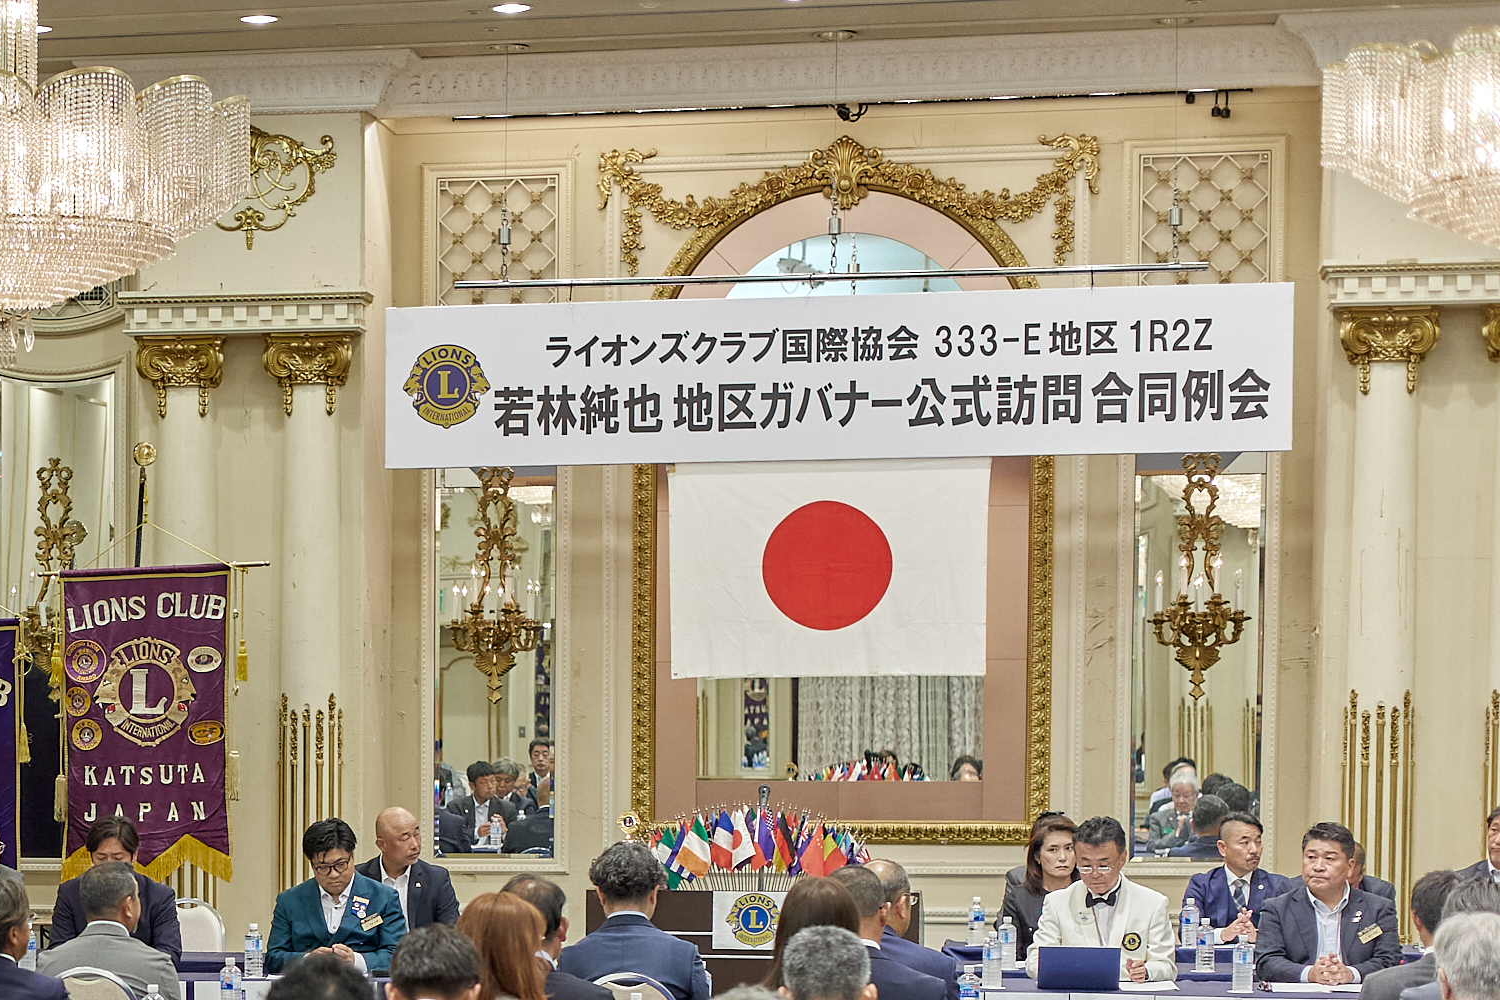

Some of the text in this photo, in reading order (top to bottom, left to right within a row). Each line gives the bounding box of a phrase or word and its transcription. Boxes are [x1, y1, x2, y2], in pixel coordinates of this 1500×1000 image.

[545, 325, 920, 369] ライオンズクラブ国際協会
[1129, 318, 1213, 353] 1R2Z
[422, 348, 472, 366] LIONS
[437, 370, 460, 399] L
[493, 368, 1271, 437] 若林純也 地区ガバナー公式訪問 合同例会
[422, 406, 472, 422] INTERNATIONAL
[66, 592, 227, 633] LIONS CLUB
[118, 642, 174, 665] LIONS
[129, 668, 168, 715] L
[120, 718, 176, 739] INTERNATIONAL
[84, 762, 205, 786] KATSUTA
[83, 800, 206, 822] JAPAN
[738, 895, 772, 907] LIONS
[748, 909, 764, 929] L
[739, 933, 772, 944] INTERNATIONAL
